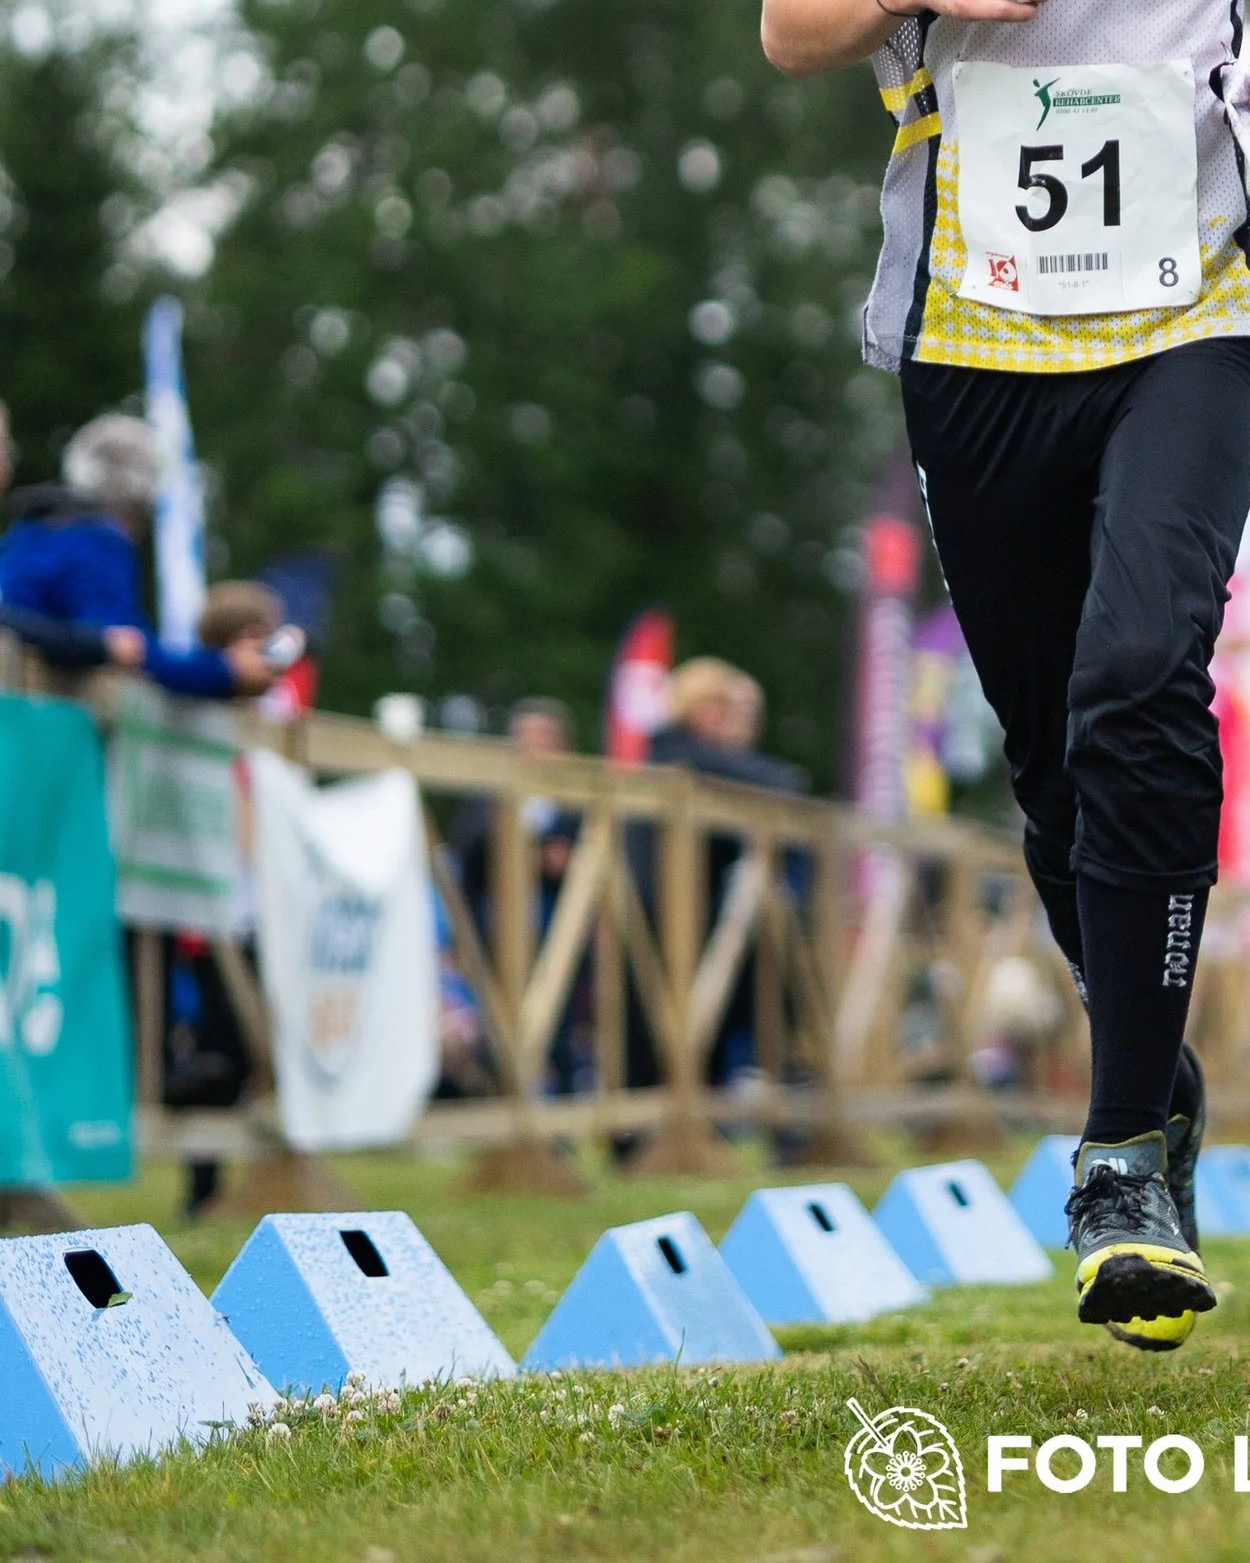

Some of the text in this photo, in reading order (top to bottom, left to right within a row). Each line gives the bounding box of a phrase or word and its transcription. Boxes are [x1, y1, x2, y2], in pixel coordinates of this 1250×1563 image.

[1054, 94, 1121, 107] REHABCENTER
[1014, 138, 1121, 232] 51
[1158, 256, 1179, 287] 8
